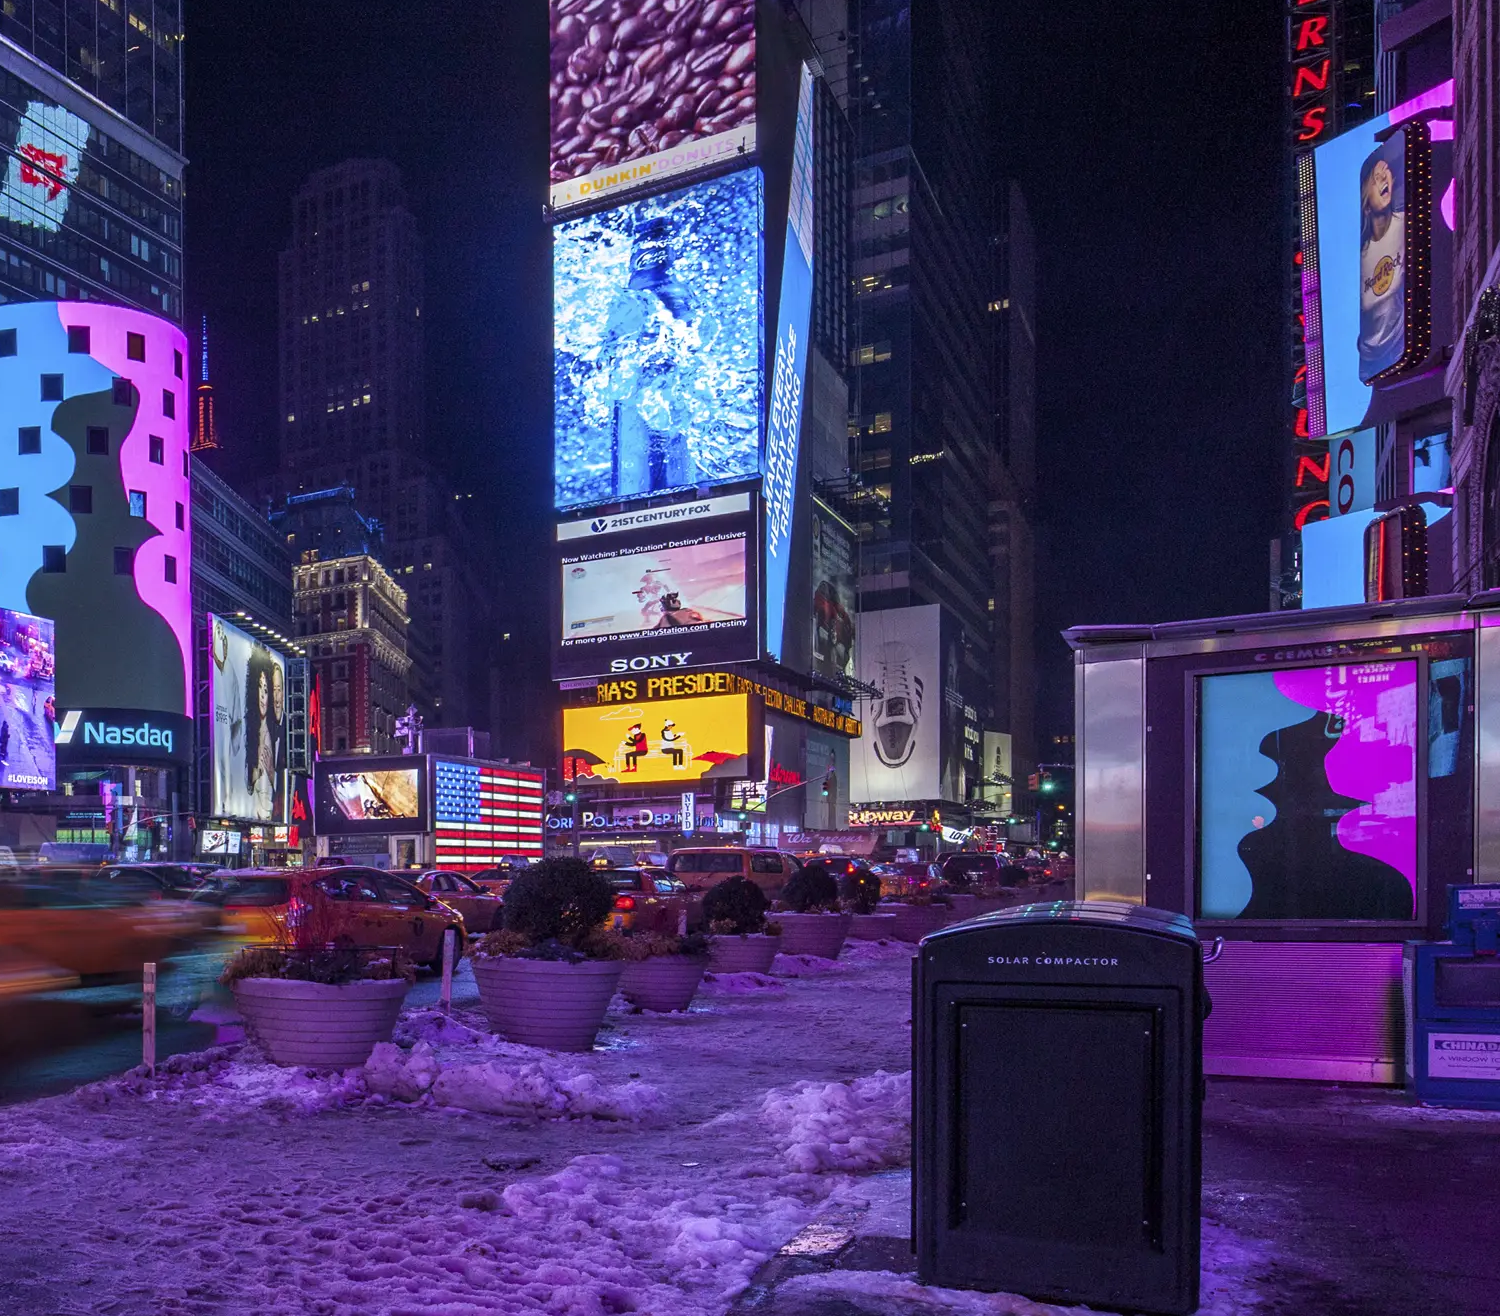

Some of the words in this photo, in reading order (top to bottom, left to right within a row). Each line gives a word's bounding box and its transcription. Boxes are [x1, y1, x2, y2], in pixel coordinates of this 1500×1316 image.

[580, 161, 657, 195] DUNKIN'
[658, 138, 736, 170] DONUTS
[766, 431, 778, 517] MAKE
[772, 337, 790, 424] EVERY
[769, 426, 787, 557] HEALTHY
[782, 324, 797, 420] CHOICE
[780, 373, 801, 538] REWARDING
[611, 516, 634, 528] 21ST
[636, 507, 687, 523] CENTURY
[688, 503, 710, 515] FOX
[562, 556, 578, 564] Now
[580, 550, 618, 562] Watching:
[705, 531, 746, 542] Exclusives
[561, 639, 573, 647] For
[575, 637, 595, 645] more
[597, 635, 607, 644] go
[619, 623, 709, 641] www.PlayStation.com
[710, 618, 747, 631] #Destiny
[611, 652, 693, 673] SONY
[597, 680, 637, 703] RIA'S
[648, 672, 735, 698] PRESIDENT
[84, 722, 172, 753] Nasdaq
[684, 794, 692, 830] NYPD
[988, 956, 1029, 964] SOLAR
[1036, 957, 1118, 966] COMPACTOR
